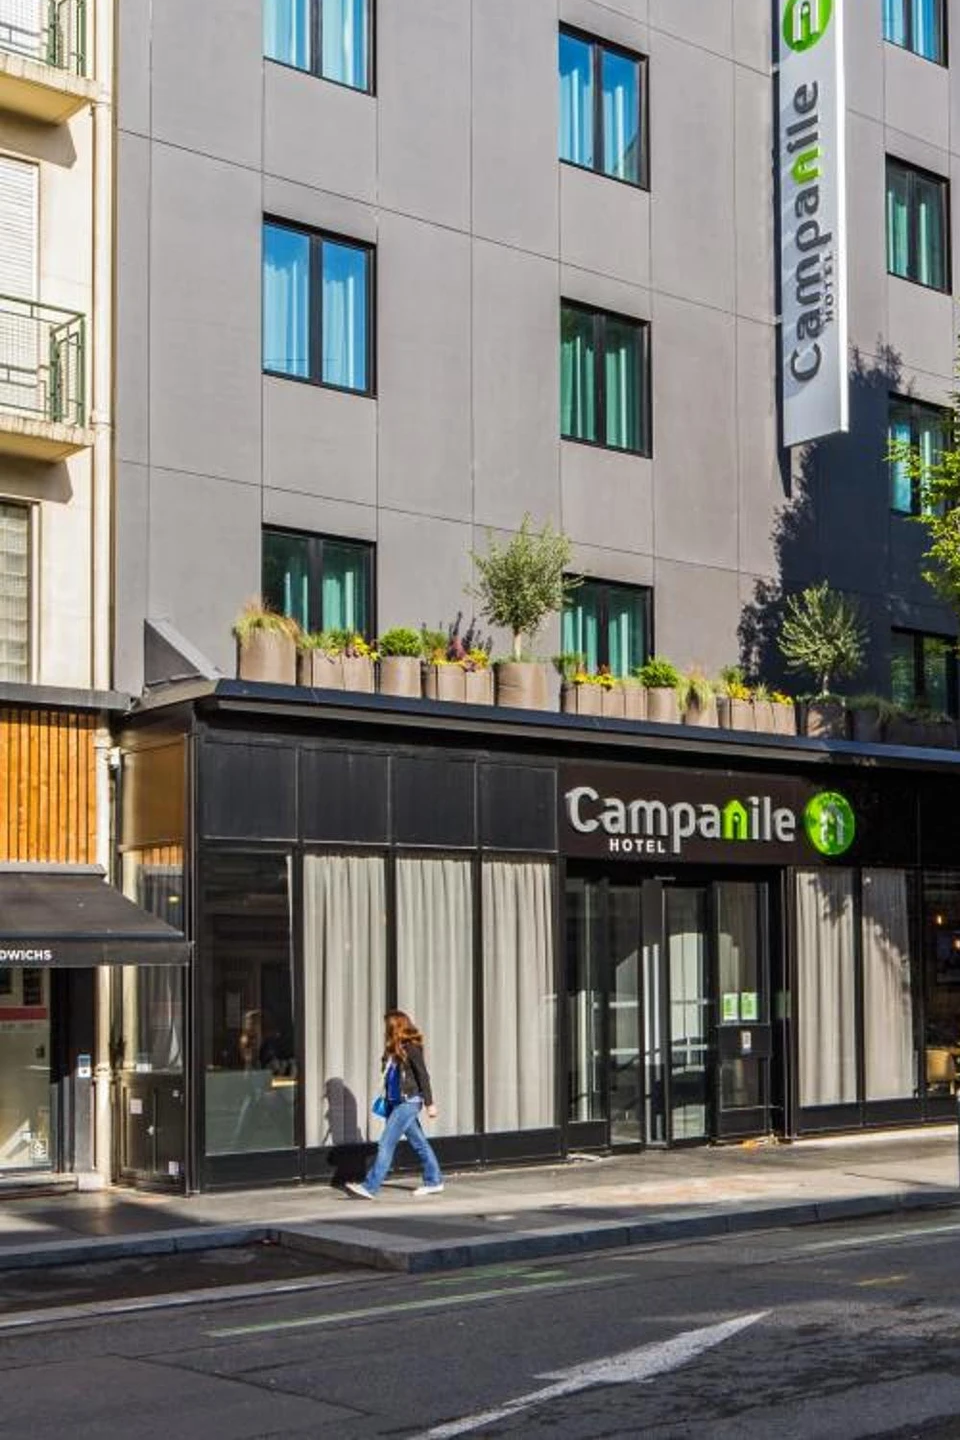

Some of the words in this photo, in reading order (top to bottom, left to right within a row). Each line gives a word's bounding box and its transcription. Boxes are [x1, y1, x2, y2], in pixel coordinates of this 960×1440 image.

[786, 80, 832, 383] Campanile
[823, 252, 834, 324] HOTEL
[565, 786, 797, 853] Campanile
[609, 838, 666, 853] HOTEL
